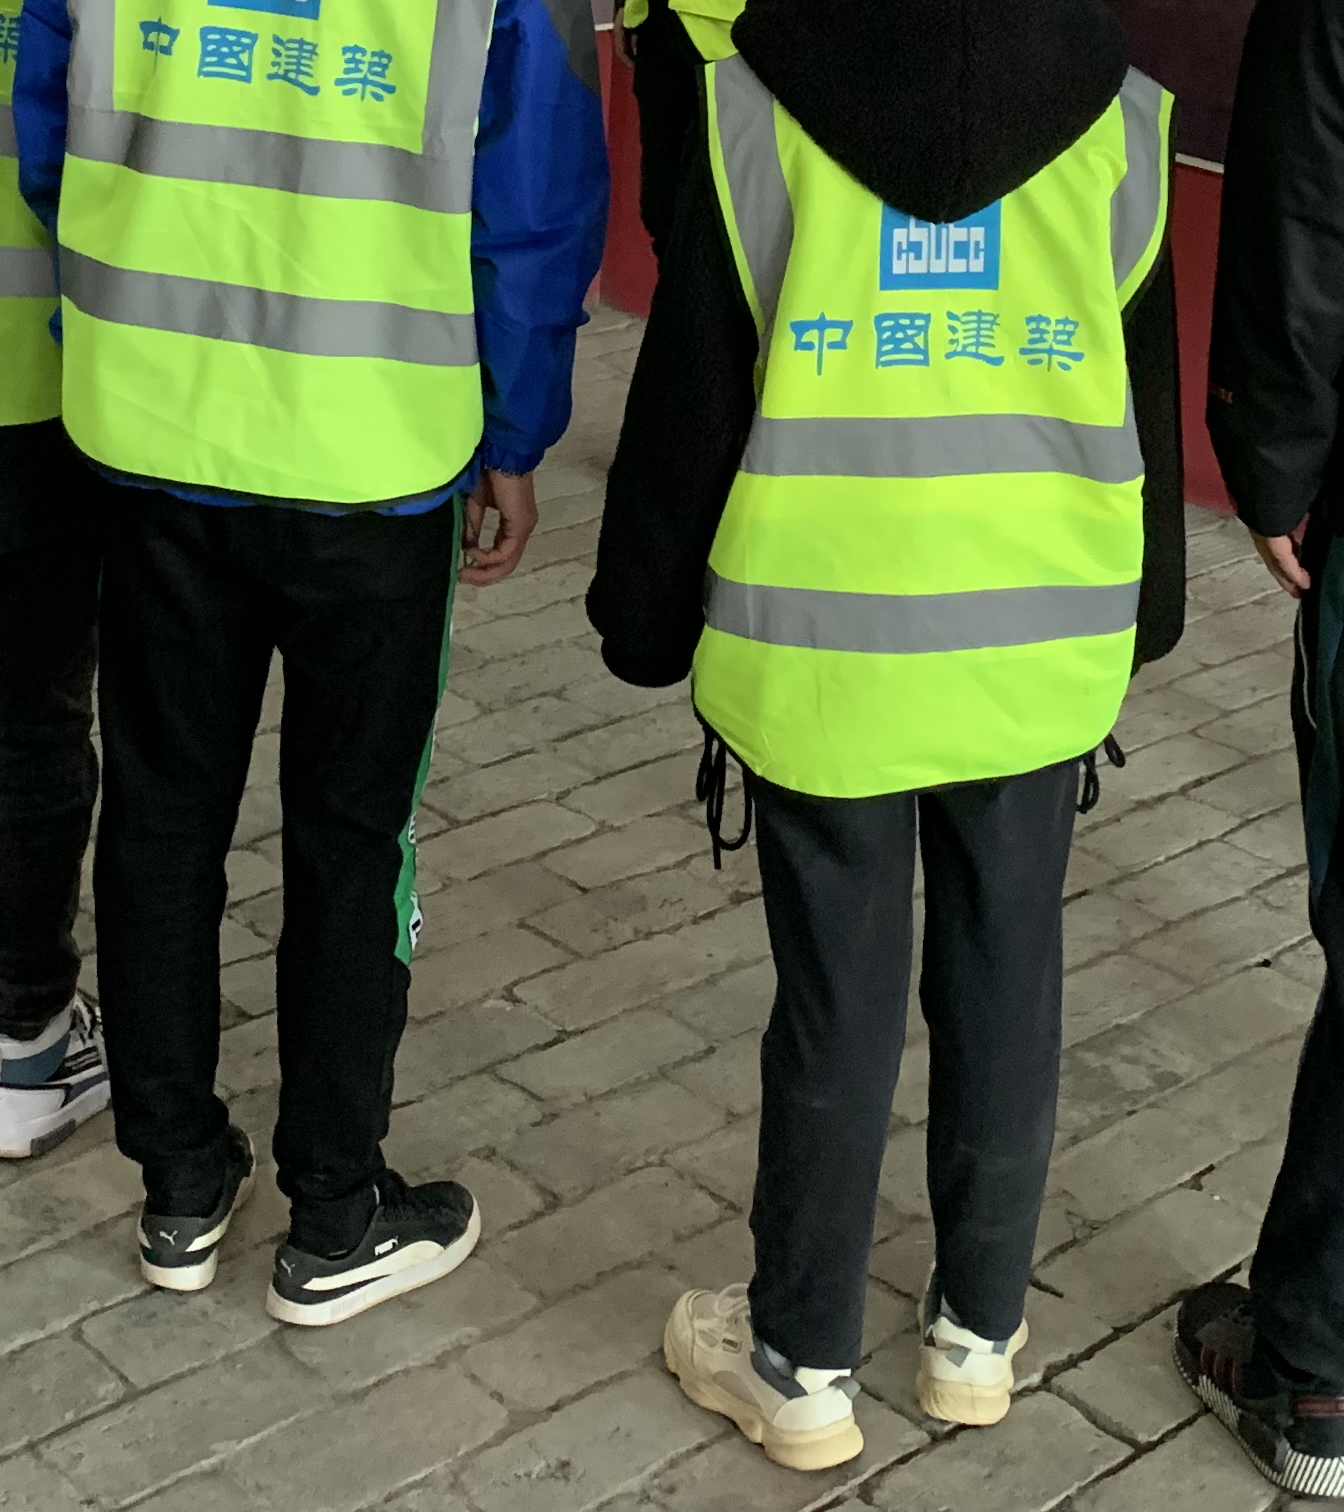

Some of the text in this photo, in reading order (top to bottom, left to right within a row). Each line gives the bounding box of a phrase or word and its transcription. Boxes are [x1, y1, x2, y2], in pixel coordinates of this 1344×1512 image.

[139, 15, 397, 102] 中國建築
[790, 310, 1085, 376] 中國建築
